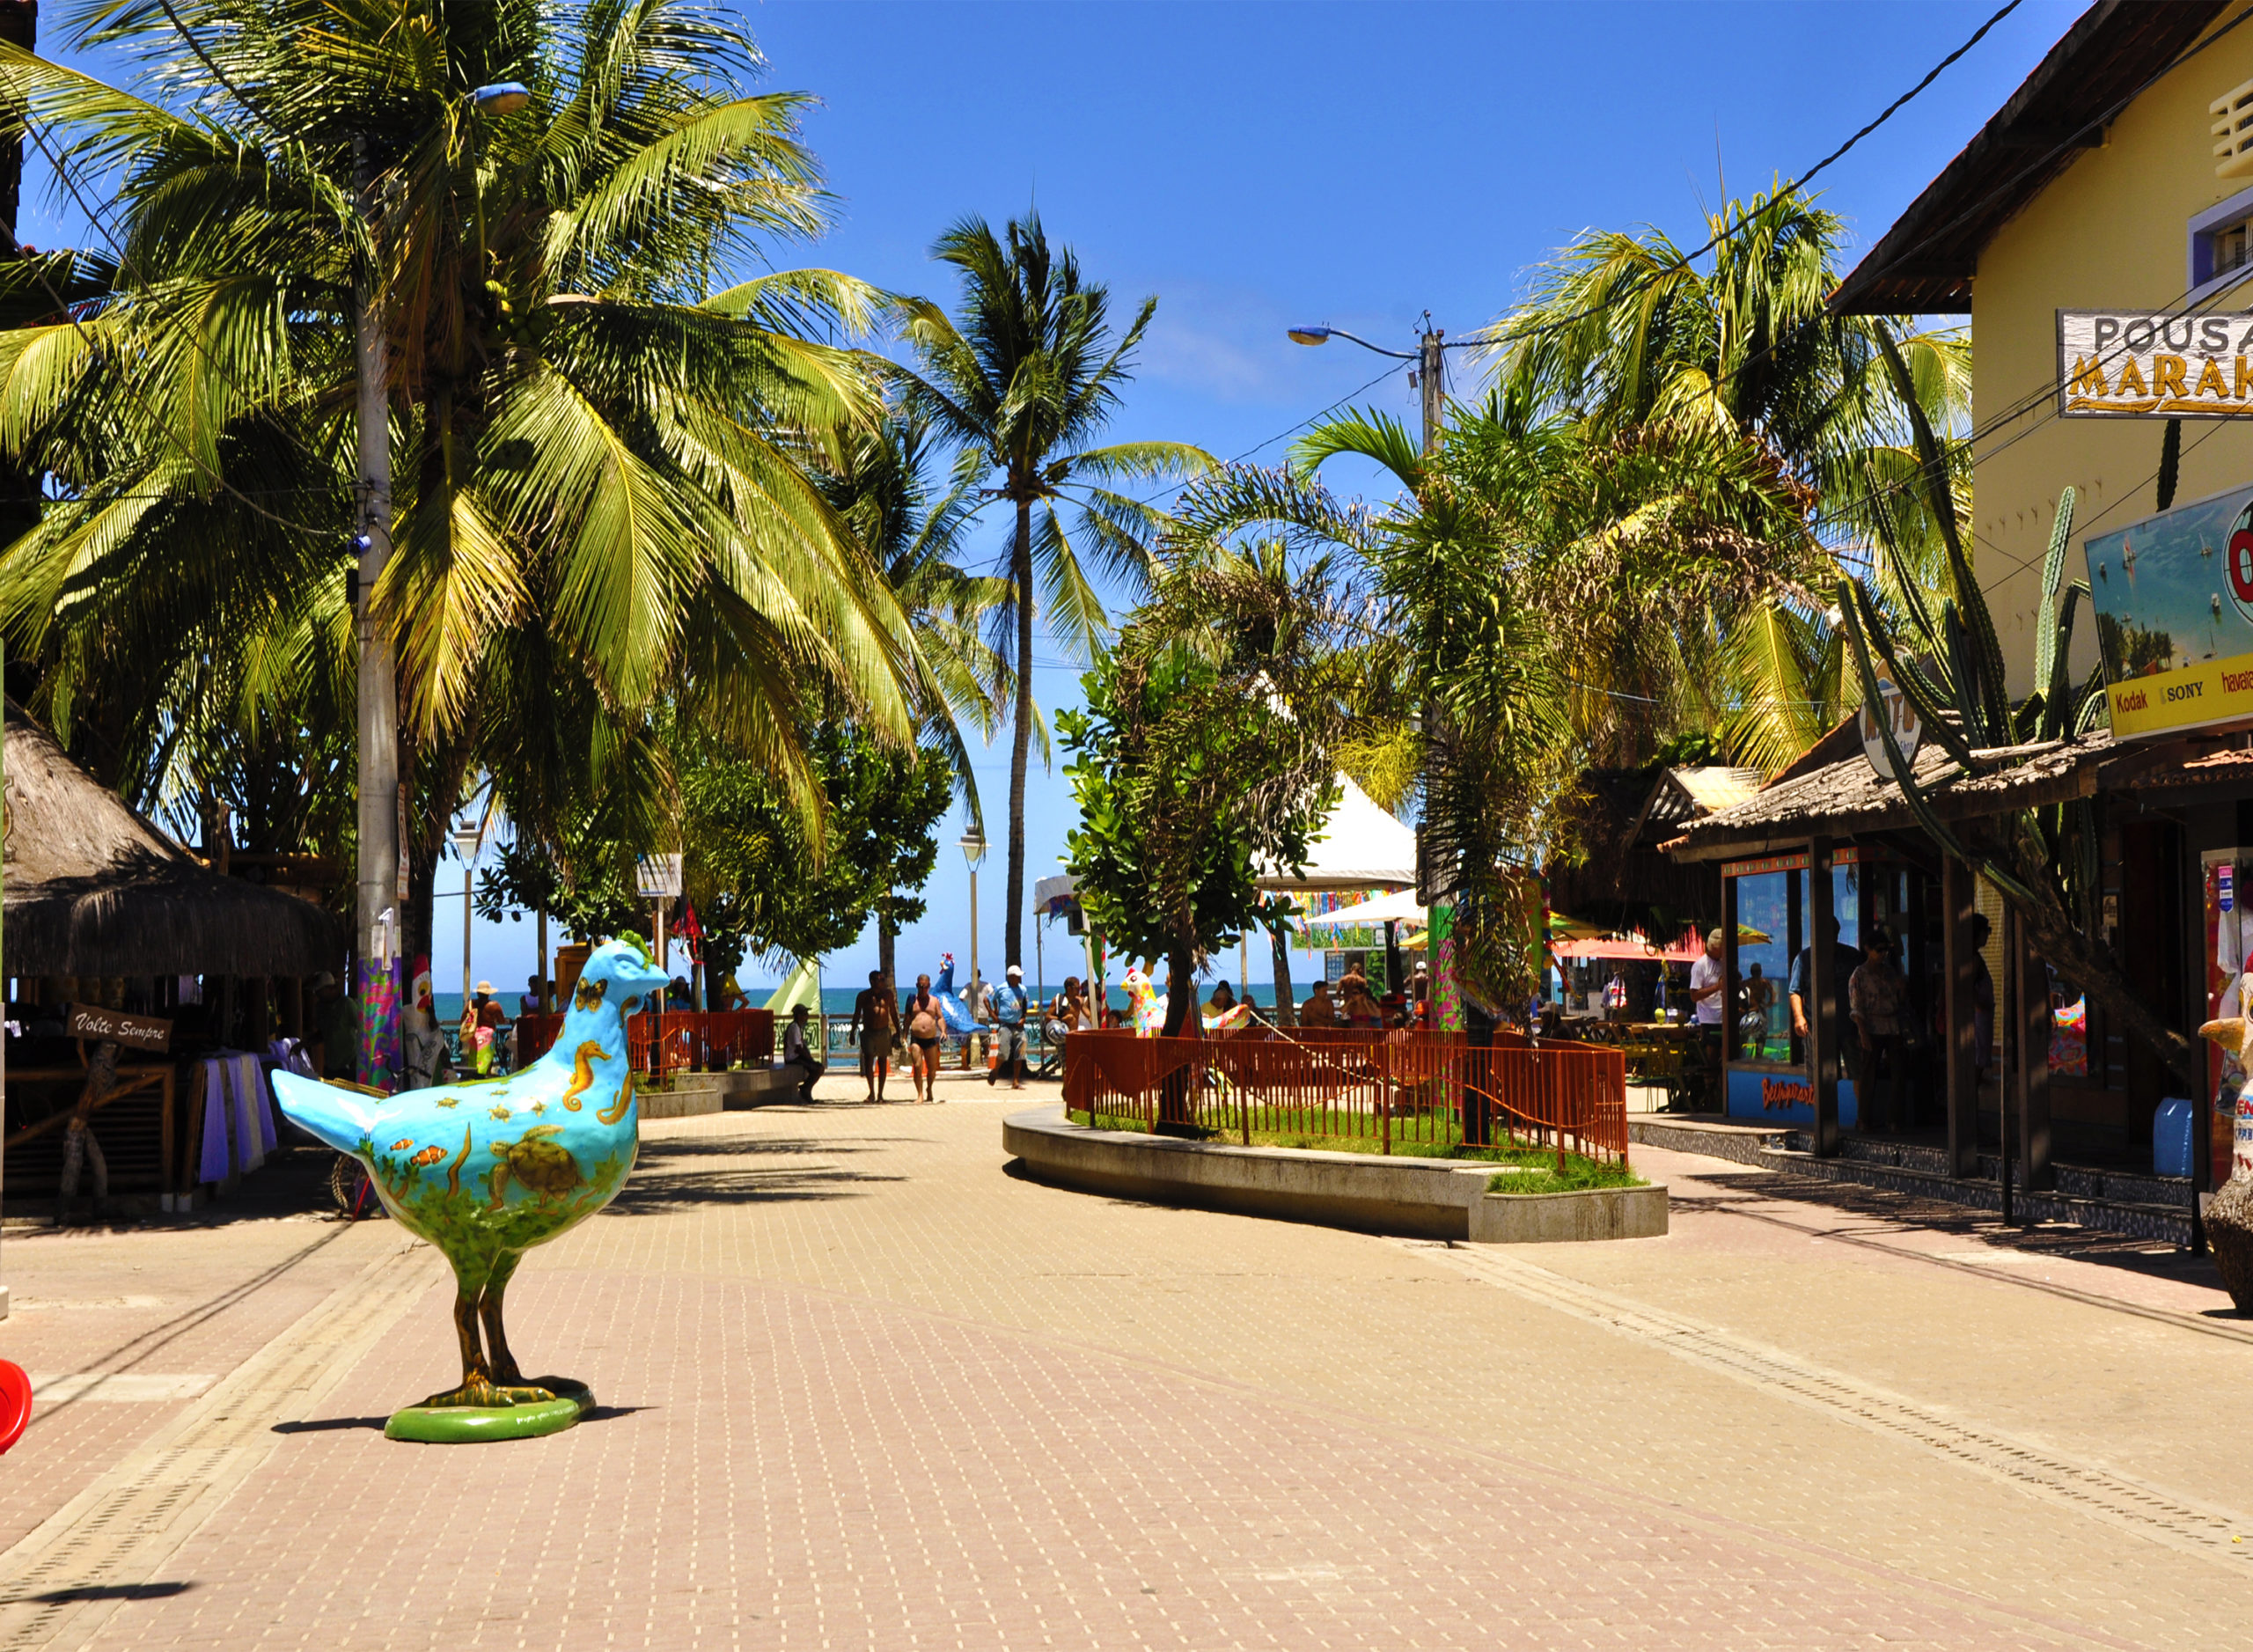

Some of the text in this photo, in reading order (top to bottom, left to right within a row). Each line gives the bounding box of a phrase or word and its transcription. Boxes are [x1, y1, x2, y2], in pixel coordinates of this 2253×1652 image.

[2116, 688, 2147, 714] Kodak
[2167, 681, 2203, 702] SONY
[76, 1012, 165, 1040] Volte Sempre
